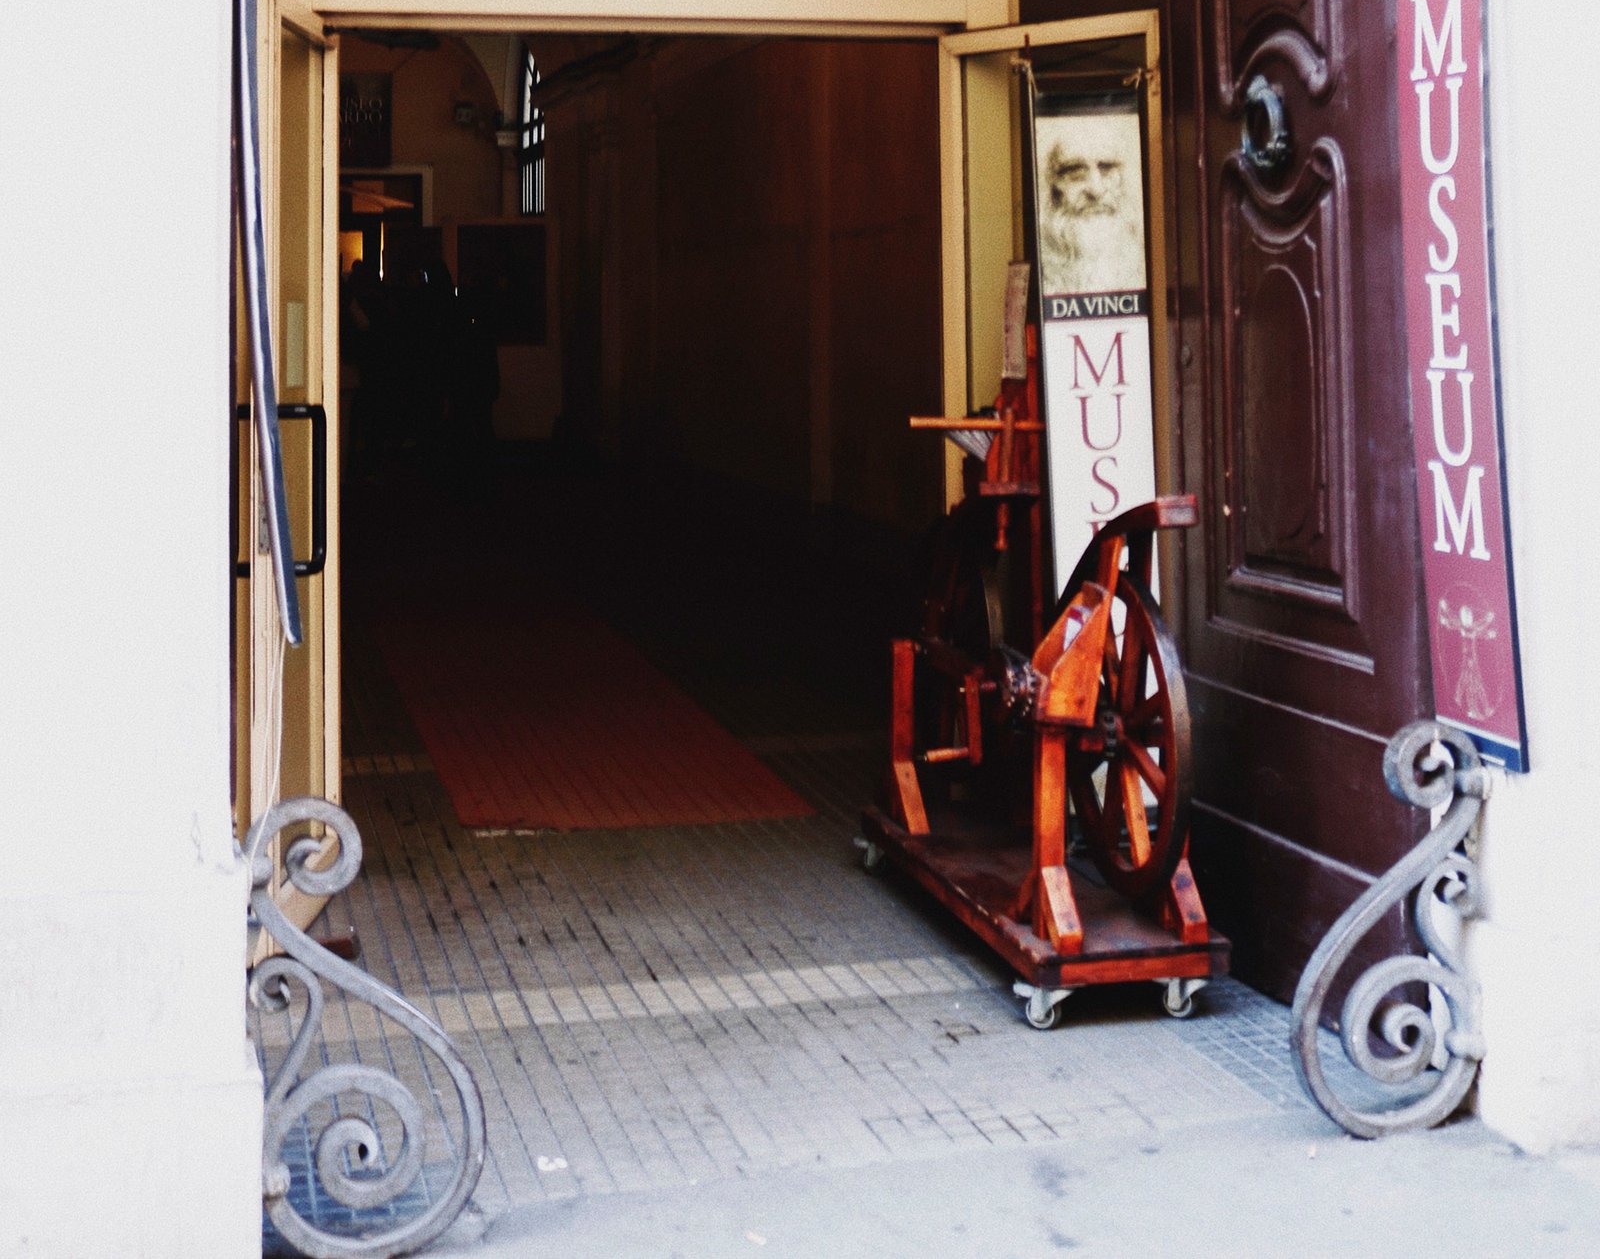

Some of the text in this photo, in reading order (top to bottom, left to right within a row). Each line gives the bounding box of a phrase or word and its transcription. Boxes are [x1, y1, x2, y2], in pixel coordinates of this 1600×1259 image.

[1052, 294, 1139, 318] DA VINCI
[1067, 328, 1129, 539] MUS
